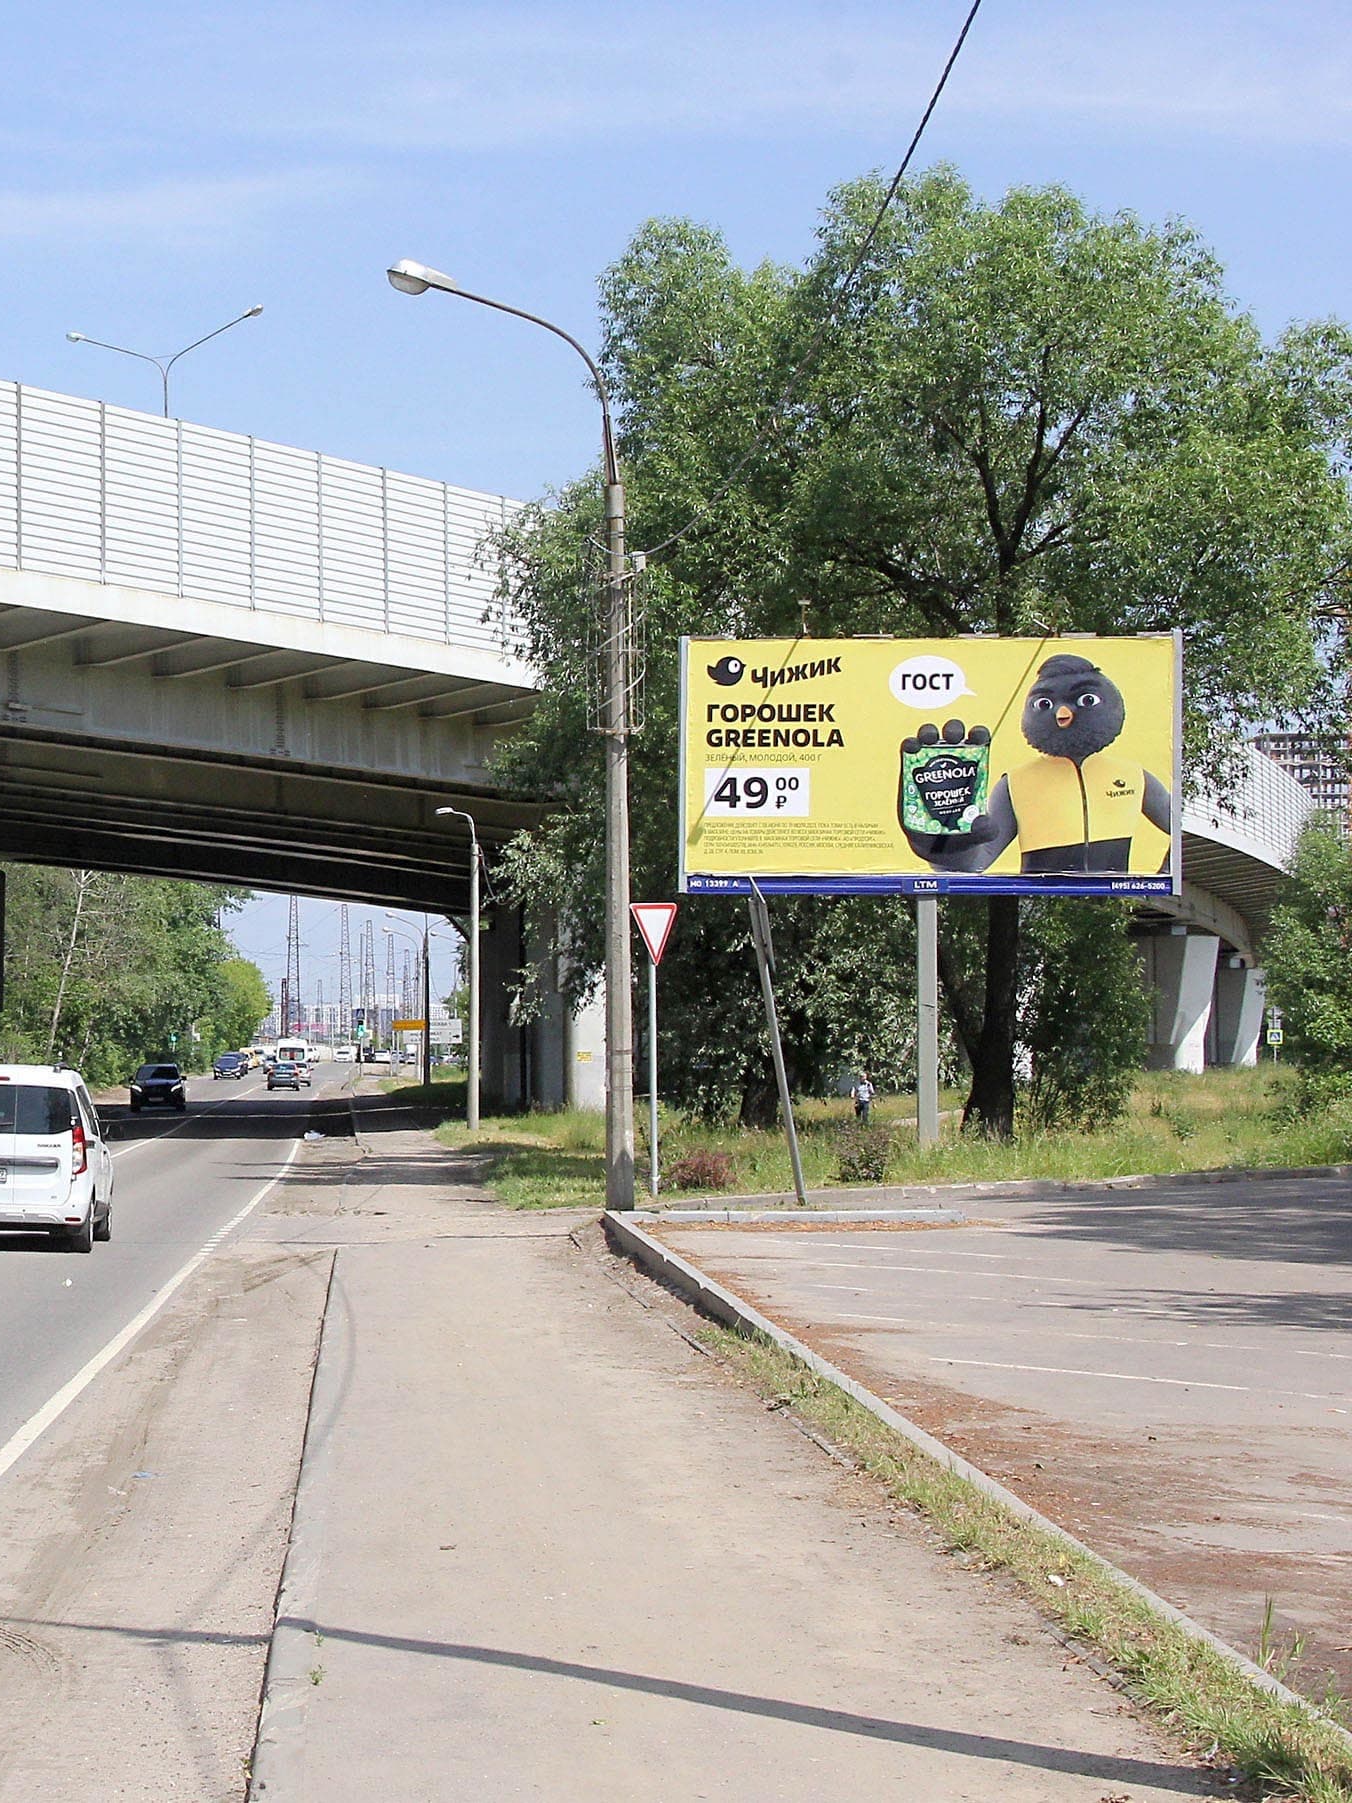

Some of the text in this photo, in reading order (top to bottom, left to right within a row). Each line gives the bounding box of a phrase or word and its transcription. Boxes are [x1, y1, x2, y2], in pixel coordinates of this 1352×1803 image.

[901, 673, 954, 691] ГОСТ
[706, 703, 836, 723] ГОРОШЕК
[706, 728, 845, 748] GREENOLA
[799, 754, 816, 762] 400
[915, 766, 976, 784] GREENOLA
[713, 776, 800, 809] 49 00
[925, 787, 972, 801] ГОРОШЕК
[914, 880, 938, 889] LTM
